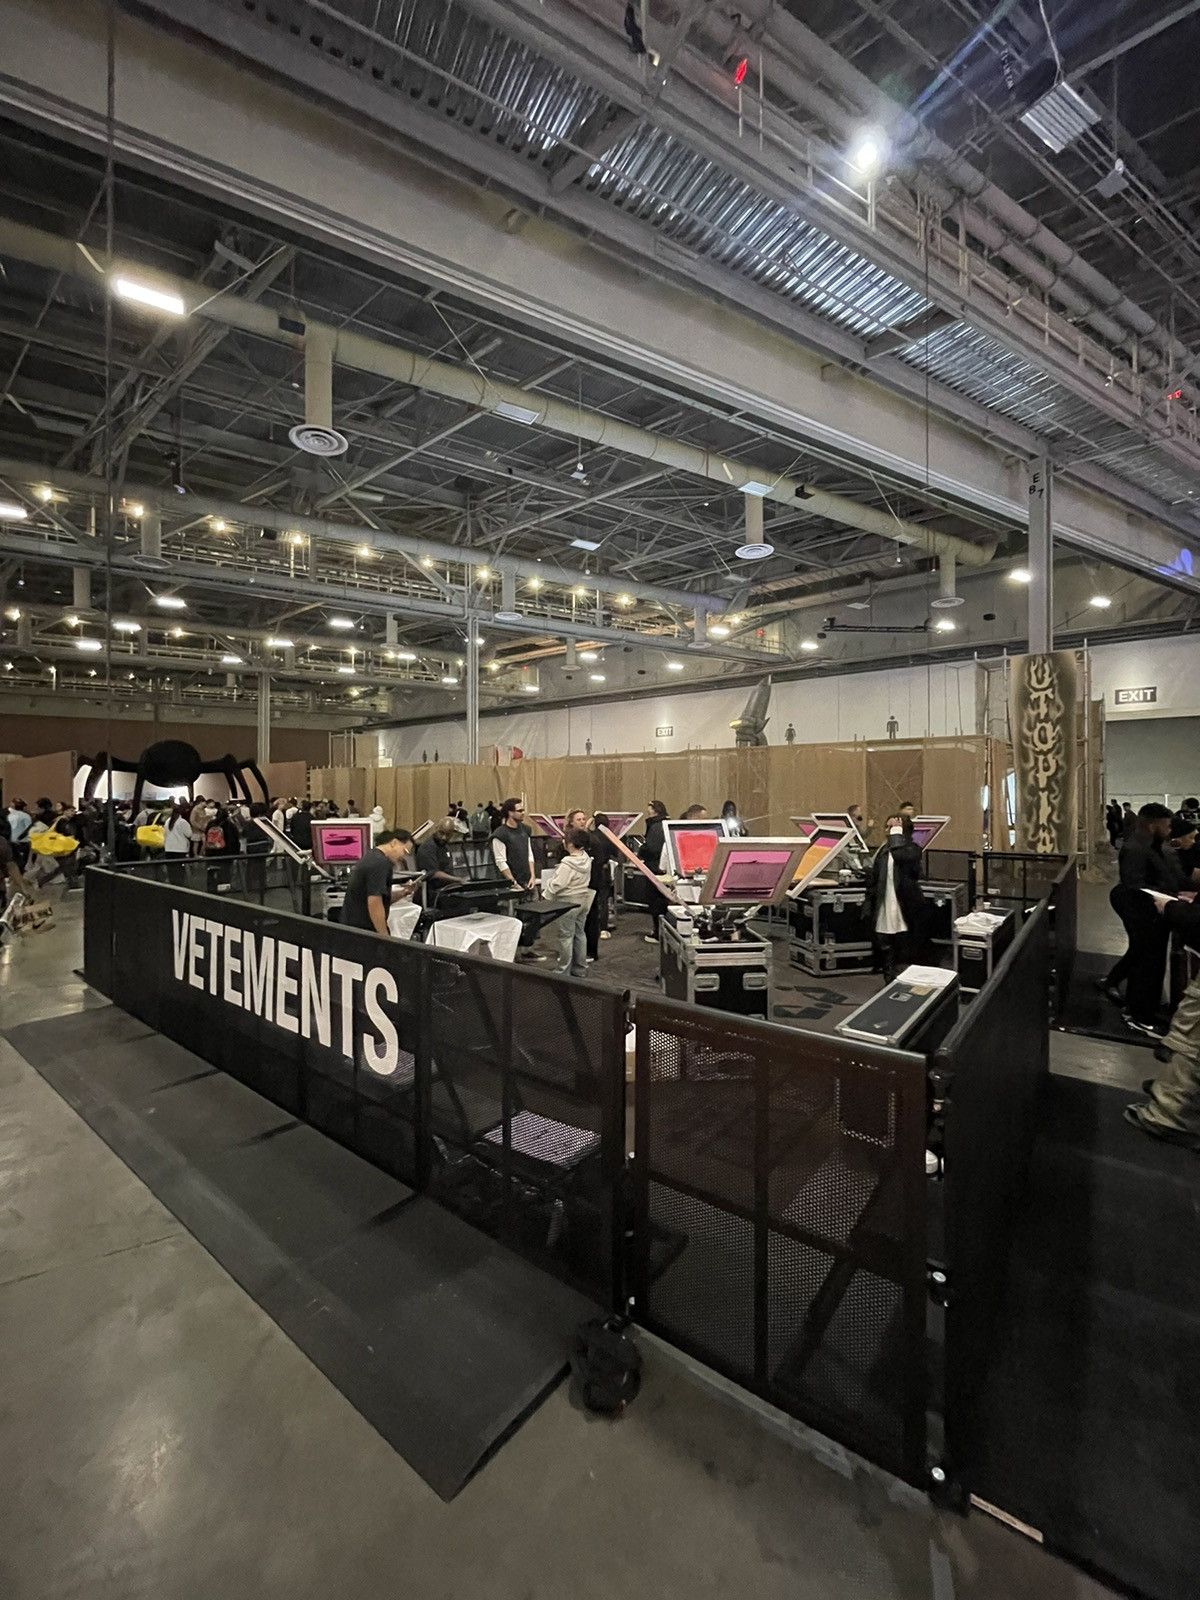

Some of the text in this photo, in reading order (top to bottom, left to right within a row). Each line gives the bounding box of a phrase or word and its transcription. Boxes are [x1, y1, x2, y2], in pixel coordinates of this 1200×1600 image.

[1033, 472, 1040, 483] E
[1119, 689, 1154, 702] EXIT
[1028, 657, 1057, 853] UTOPIA
[172, 909, 398, 1075] VETEMENTS
